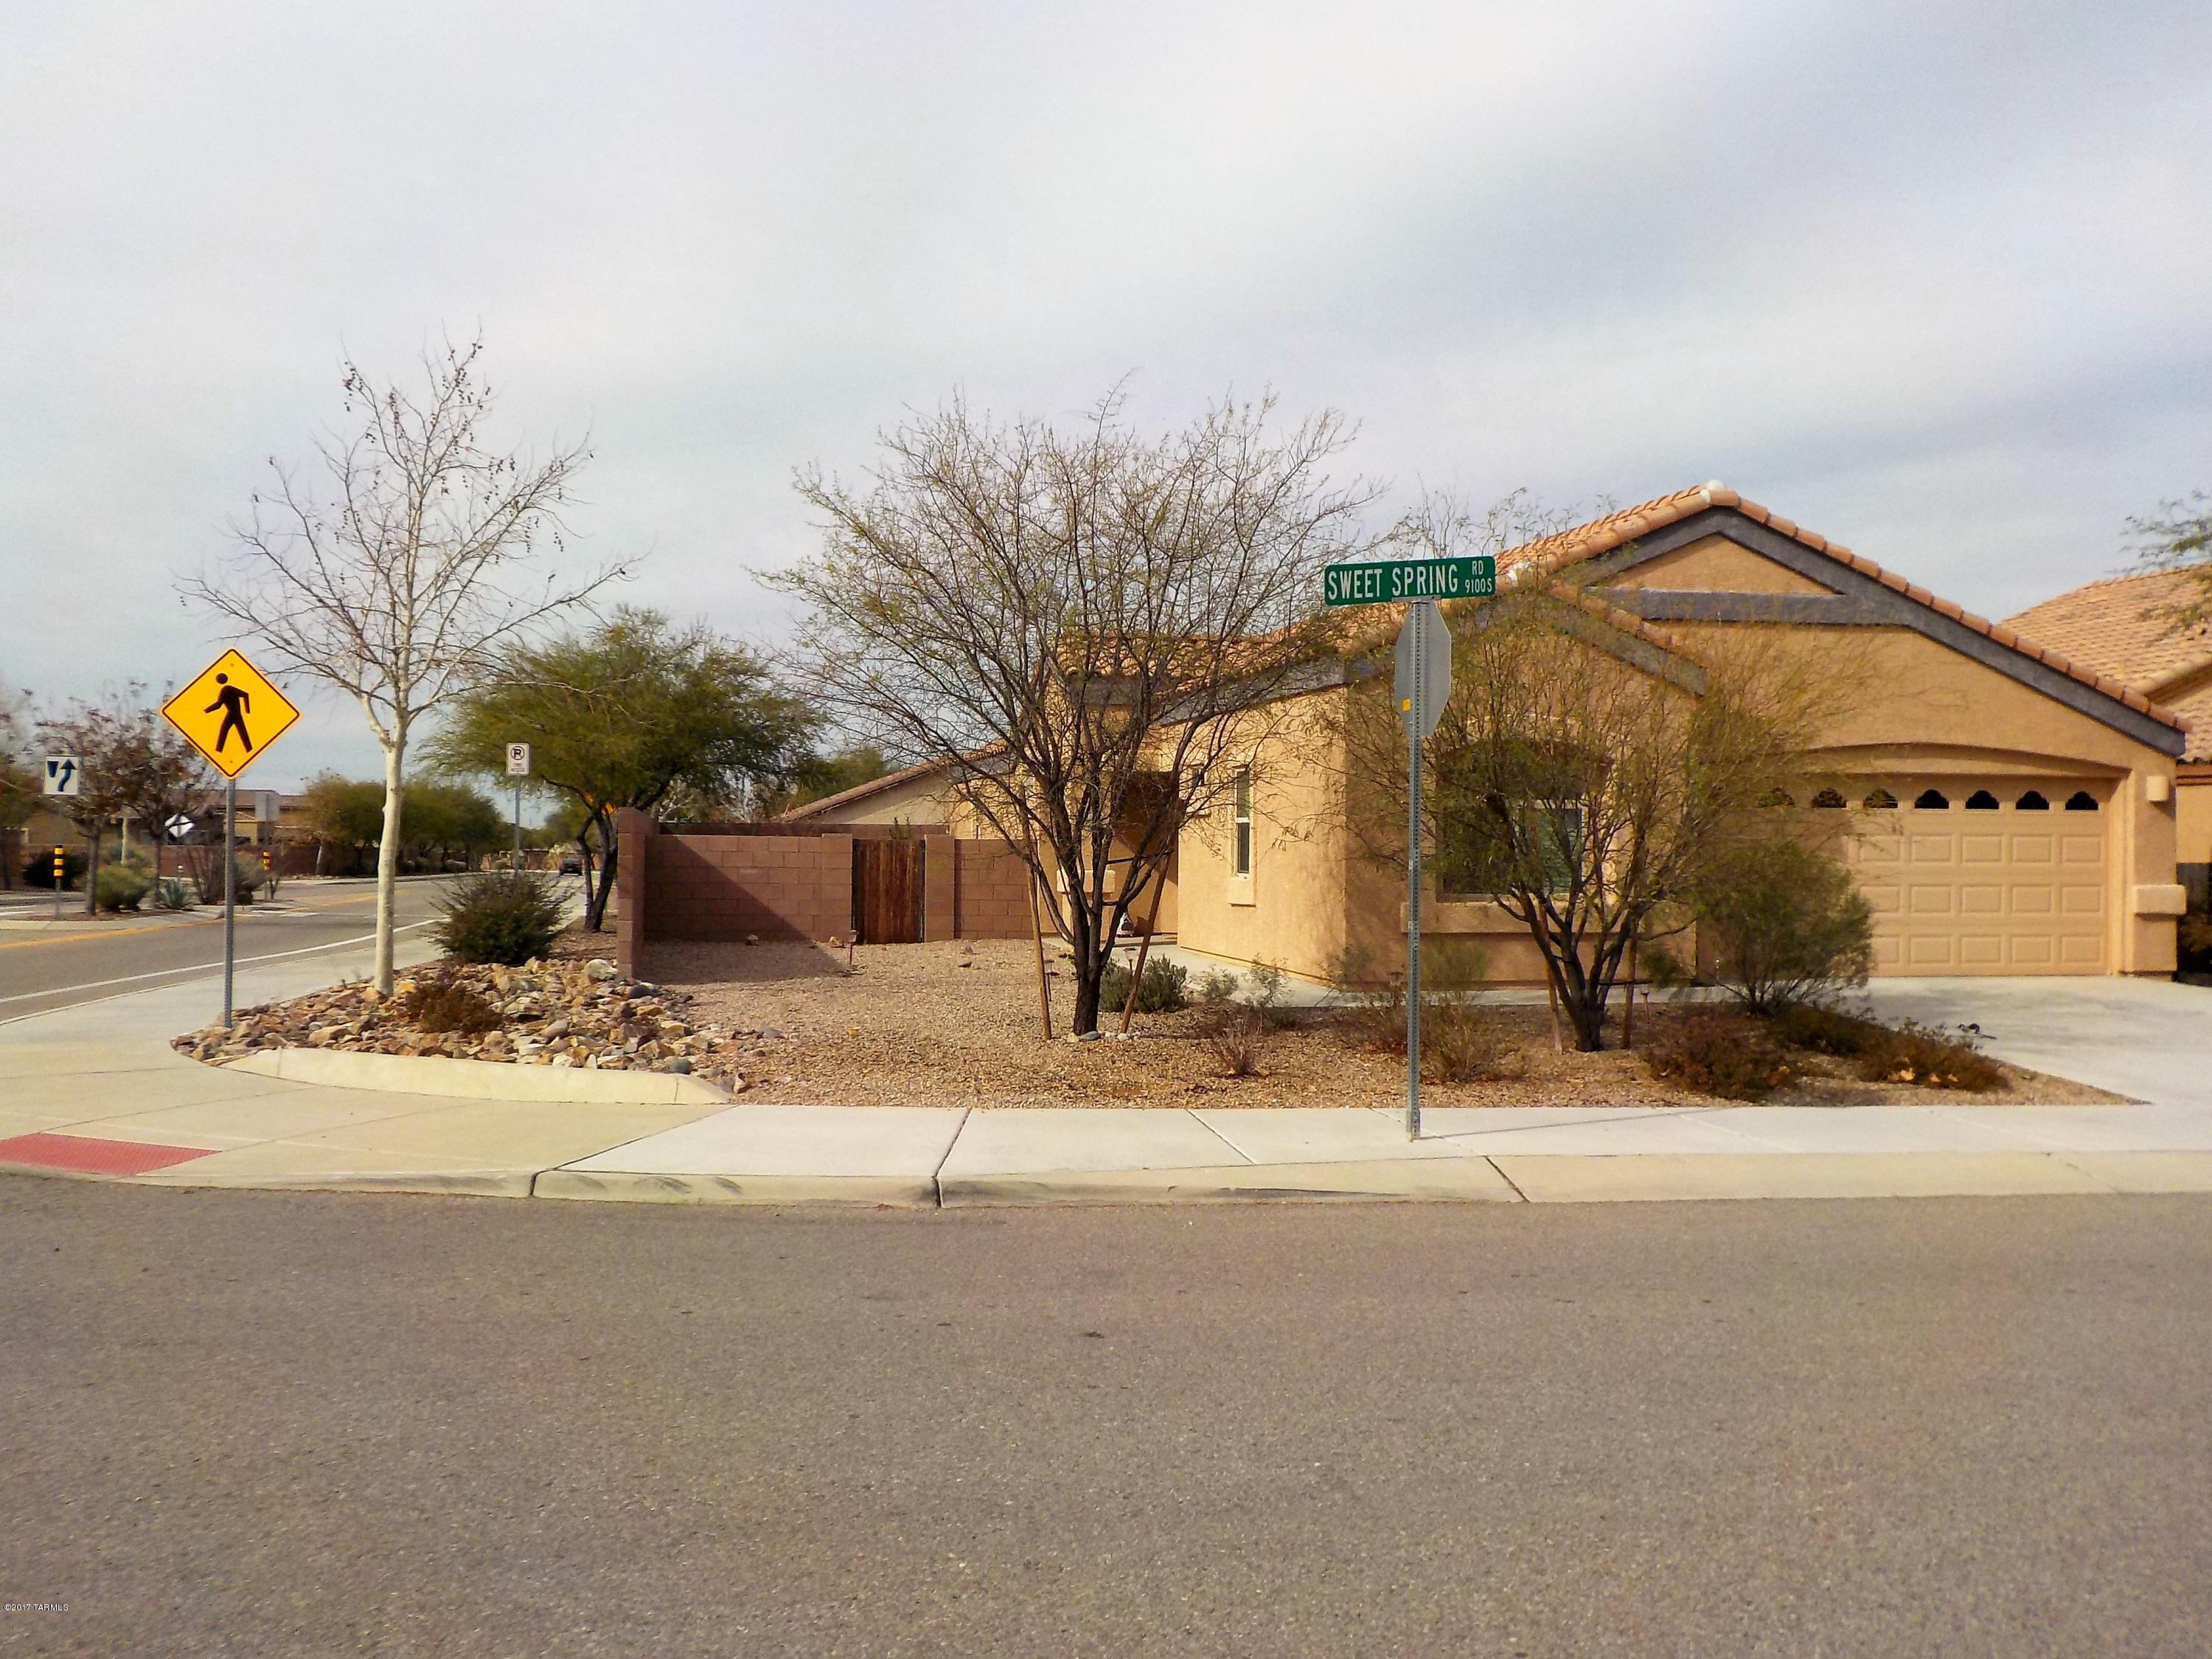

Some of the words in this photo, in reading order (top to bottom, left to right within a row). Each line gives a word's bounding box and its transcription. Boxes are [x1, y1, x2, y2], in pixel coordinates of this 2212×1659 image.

[1328, 568, 1382, 600] SWEET
[1392, 564, 1458, 597] SPRING
[1472, 560, 1484, 575] RD
